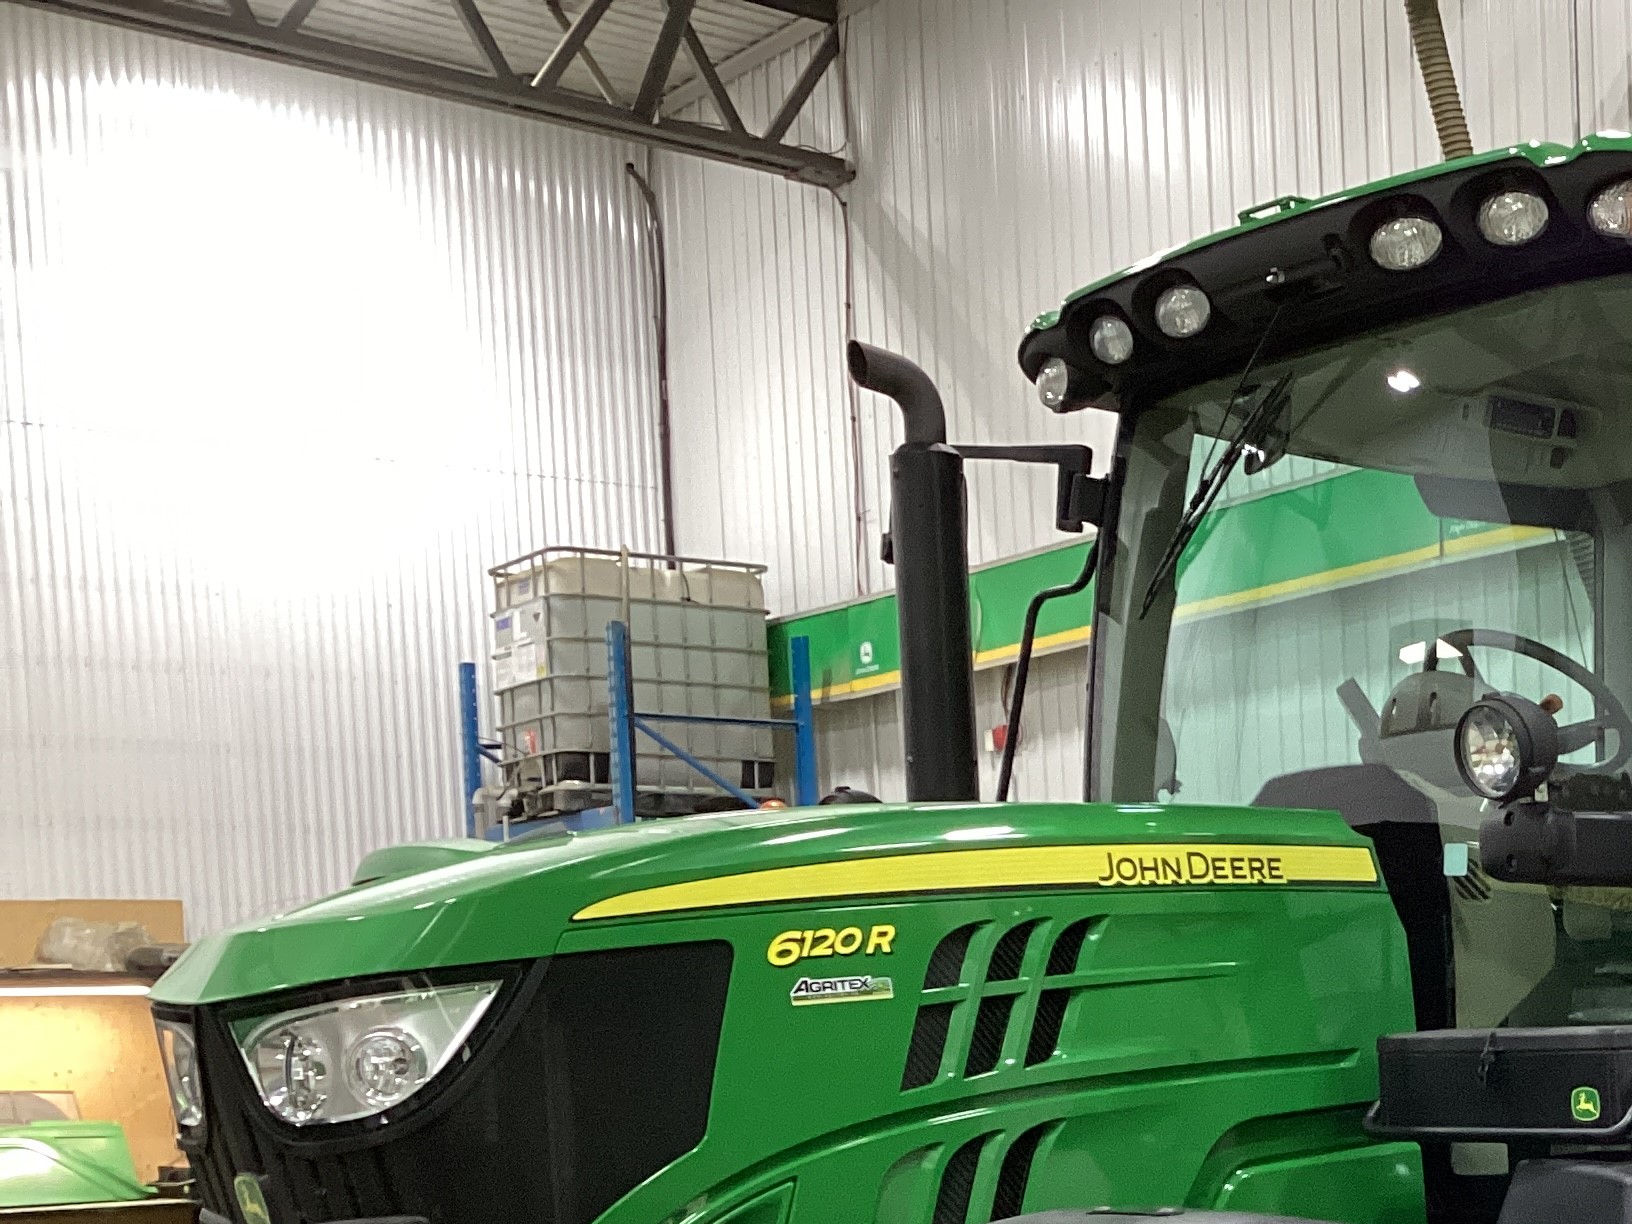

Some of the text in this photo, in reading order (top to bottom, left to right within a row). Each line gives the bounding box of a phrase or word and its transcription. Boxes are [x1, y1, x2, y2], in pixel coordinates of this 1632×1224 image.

[1098, 851, 1284, 882] JOHN DEERE
[792, 977, 871, 995] AGRITEX
